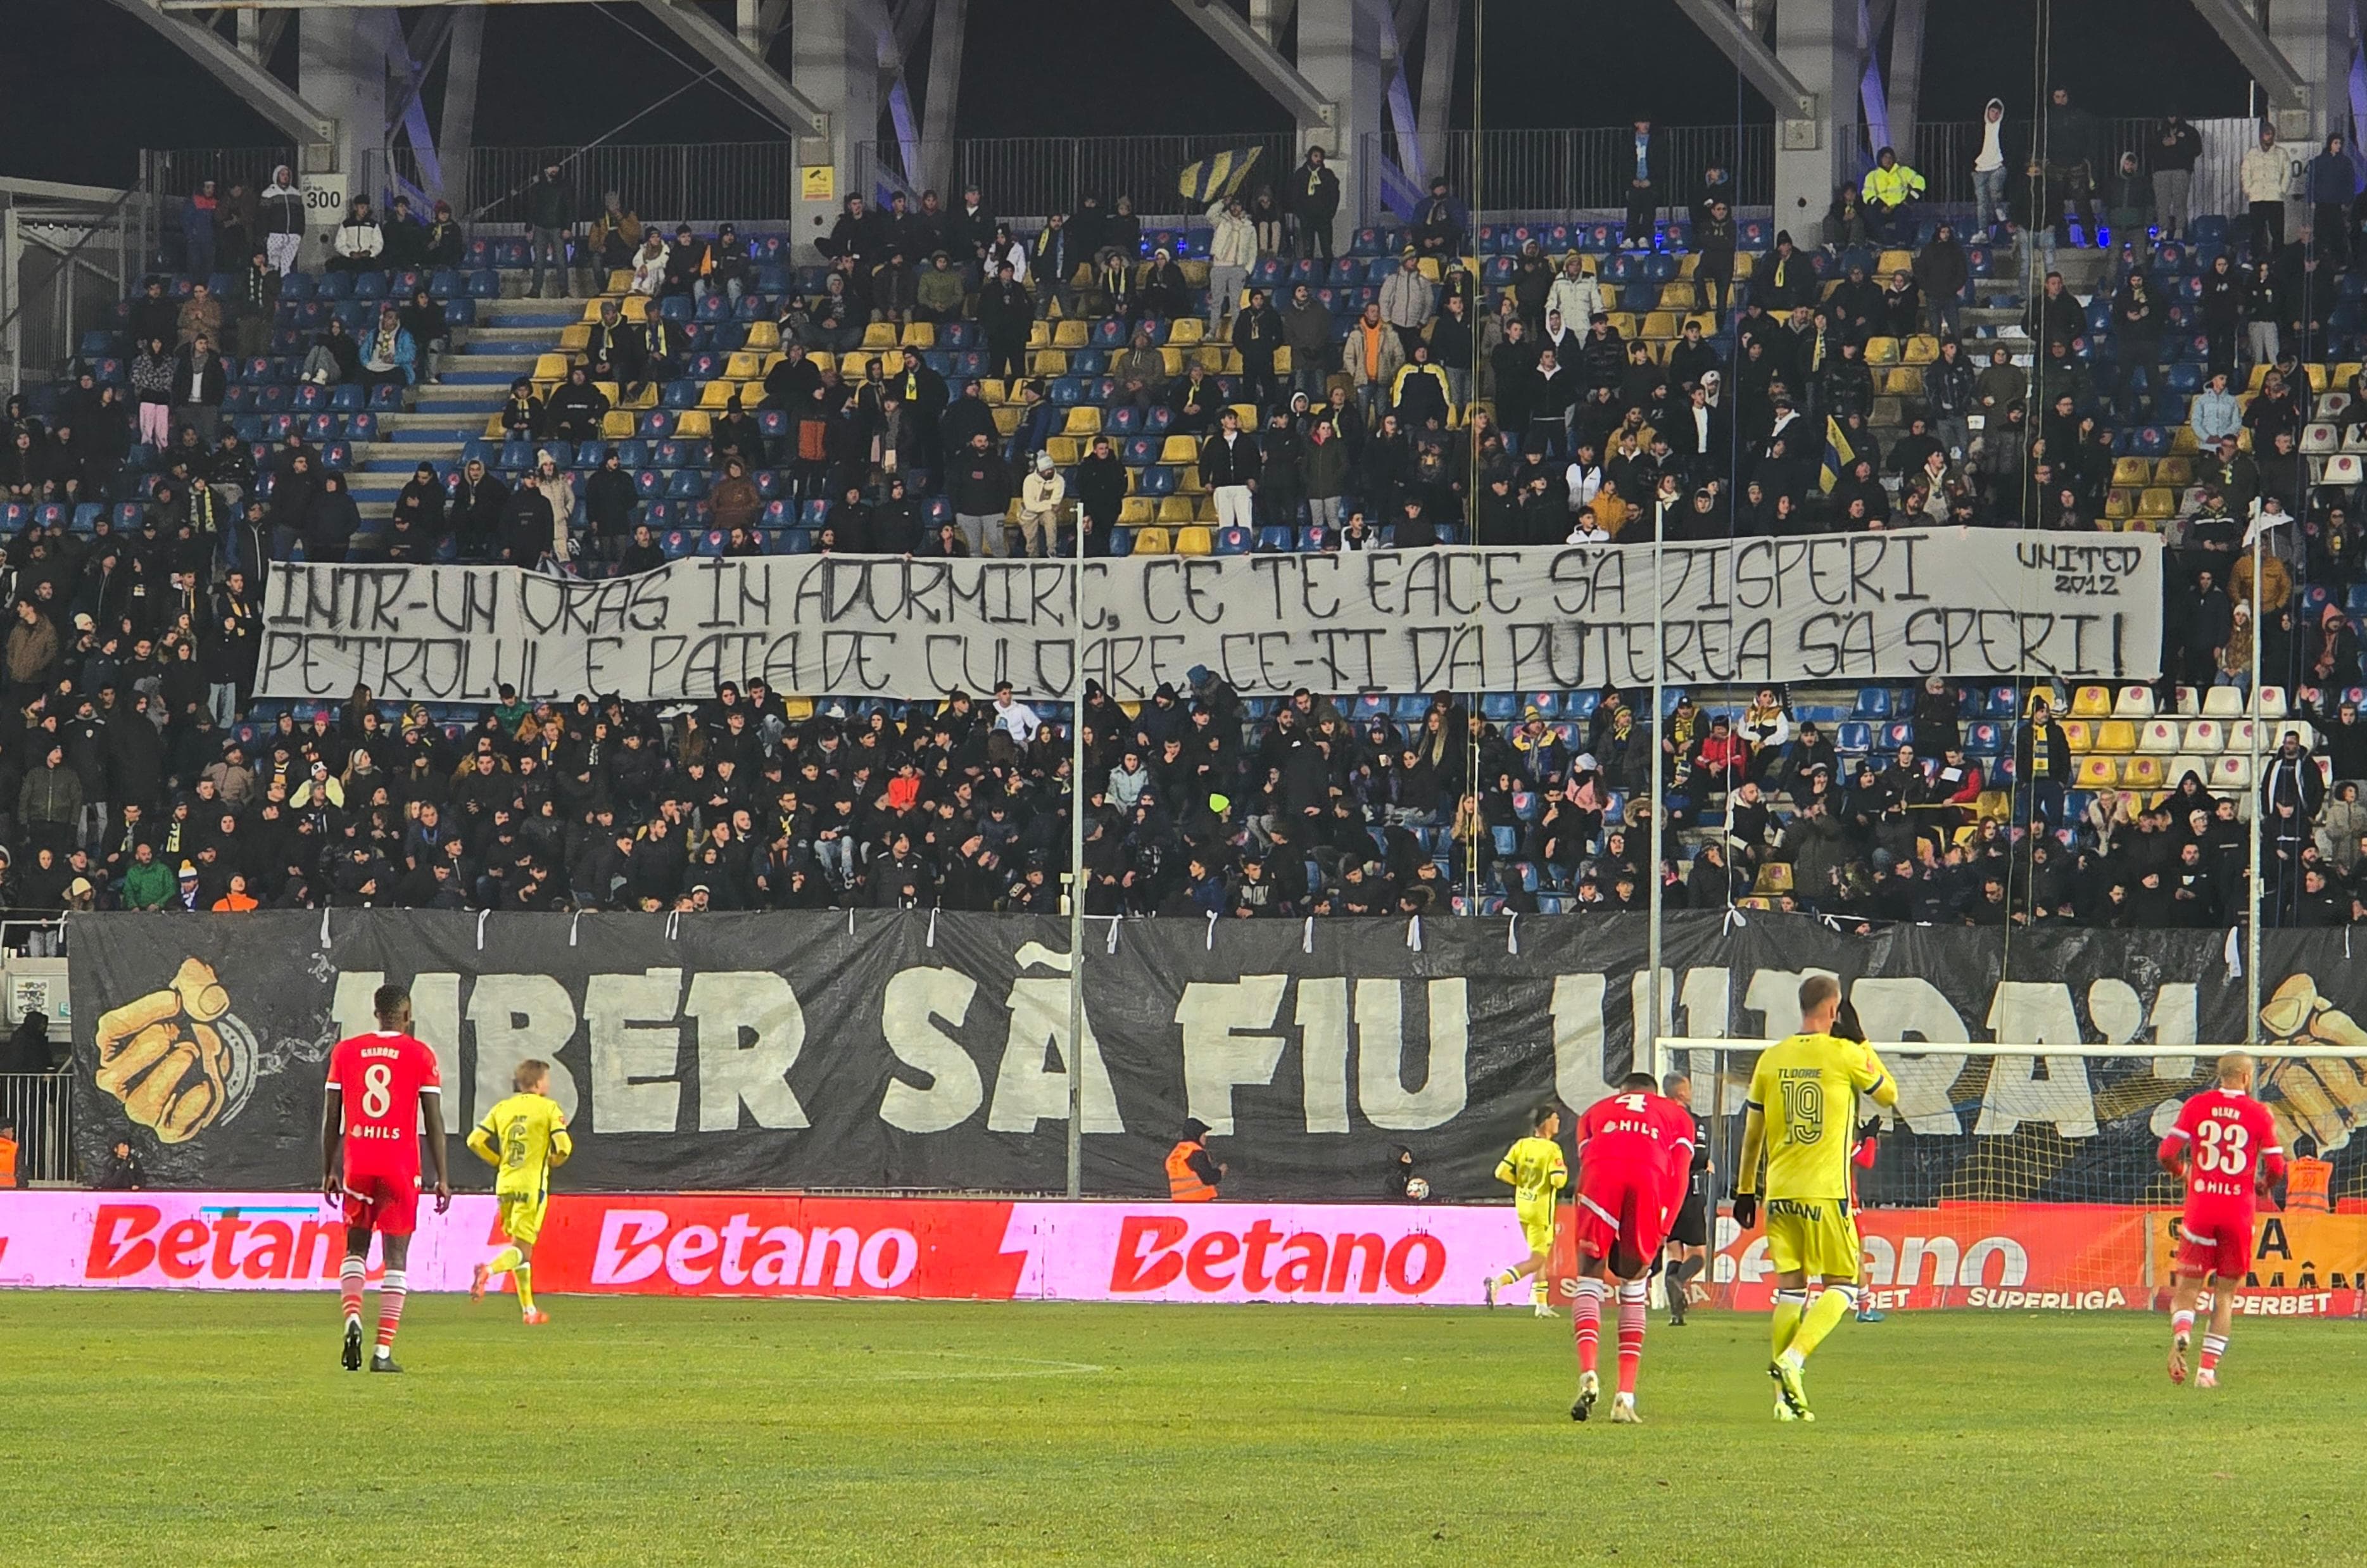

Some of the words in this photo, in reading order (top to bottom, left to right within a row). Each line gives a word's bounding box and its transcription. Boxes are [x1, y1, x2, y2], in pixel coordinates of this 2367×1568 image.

[306, 191, 341, 208] 300
[268, 564, 498, 633] INTR-UN
[1144, 559, 1224, 624] CE
[1251, 553, 1340, 619] TE
[1652, 534, 1929, 610] DISPERI
[2016, 541, 2142, 576] UNITED
[2054, 574, 2120, 596] 2012
[261, 631, 558, 699] PETROLUL
[586, 636, 622, 697] E
[823, 630, 897, 693] DE
[926, 634, 1186, 698] CULOARE
[1506, 617, 1772, 692] PUTEREA
[1905, 606, 2124, 678] SPERI!
[1175, 974, 1470, 1136] FIU
[362, 1064, 391, 1118] 8
[1614, 1094, 1648, 1113] 4
[1781, 1080, 1823, 1145] 19
[2197, 1120, 2249, 1175] 33
[84, 1203, 384, 1280] Betan
[591, 1209, 919, 1289] Betano
[1109, 1215, 1447, 1294] Betano
[1691, 1216, 2028, 1287] Beano
[1967, 1287, 2126, 1310] SUPERLIGA
